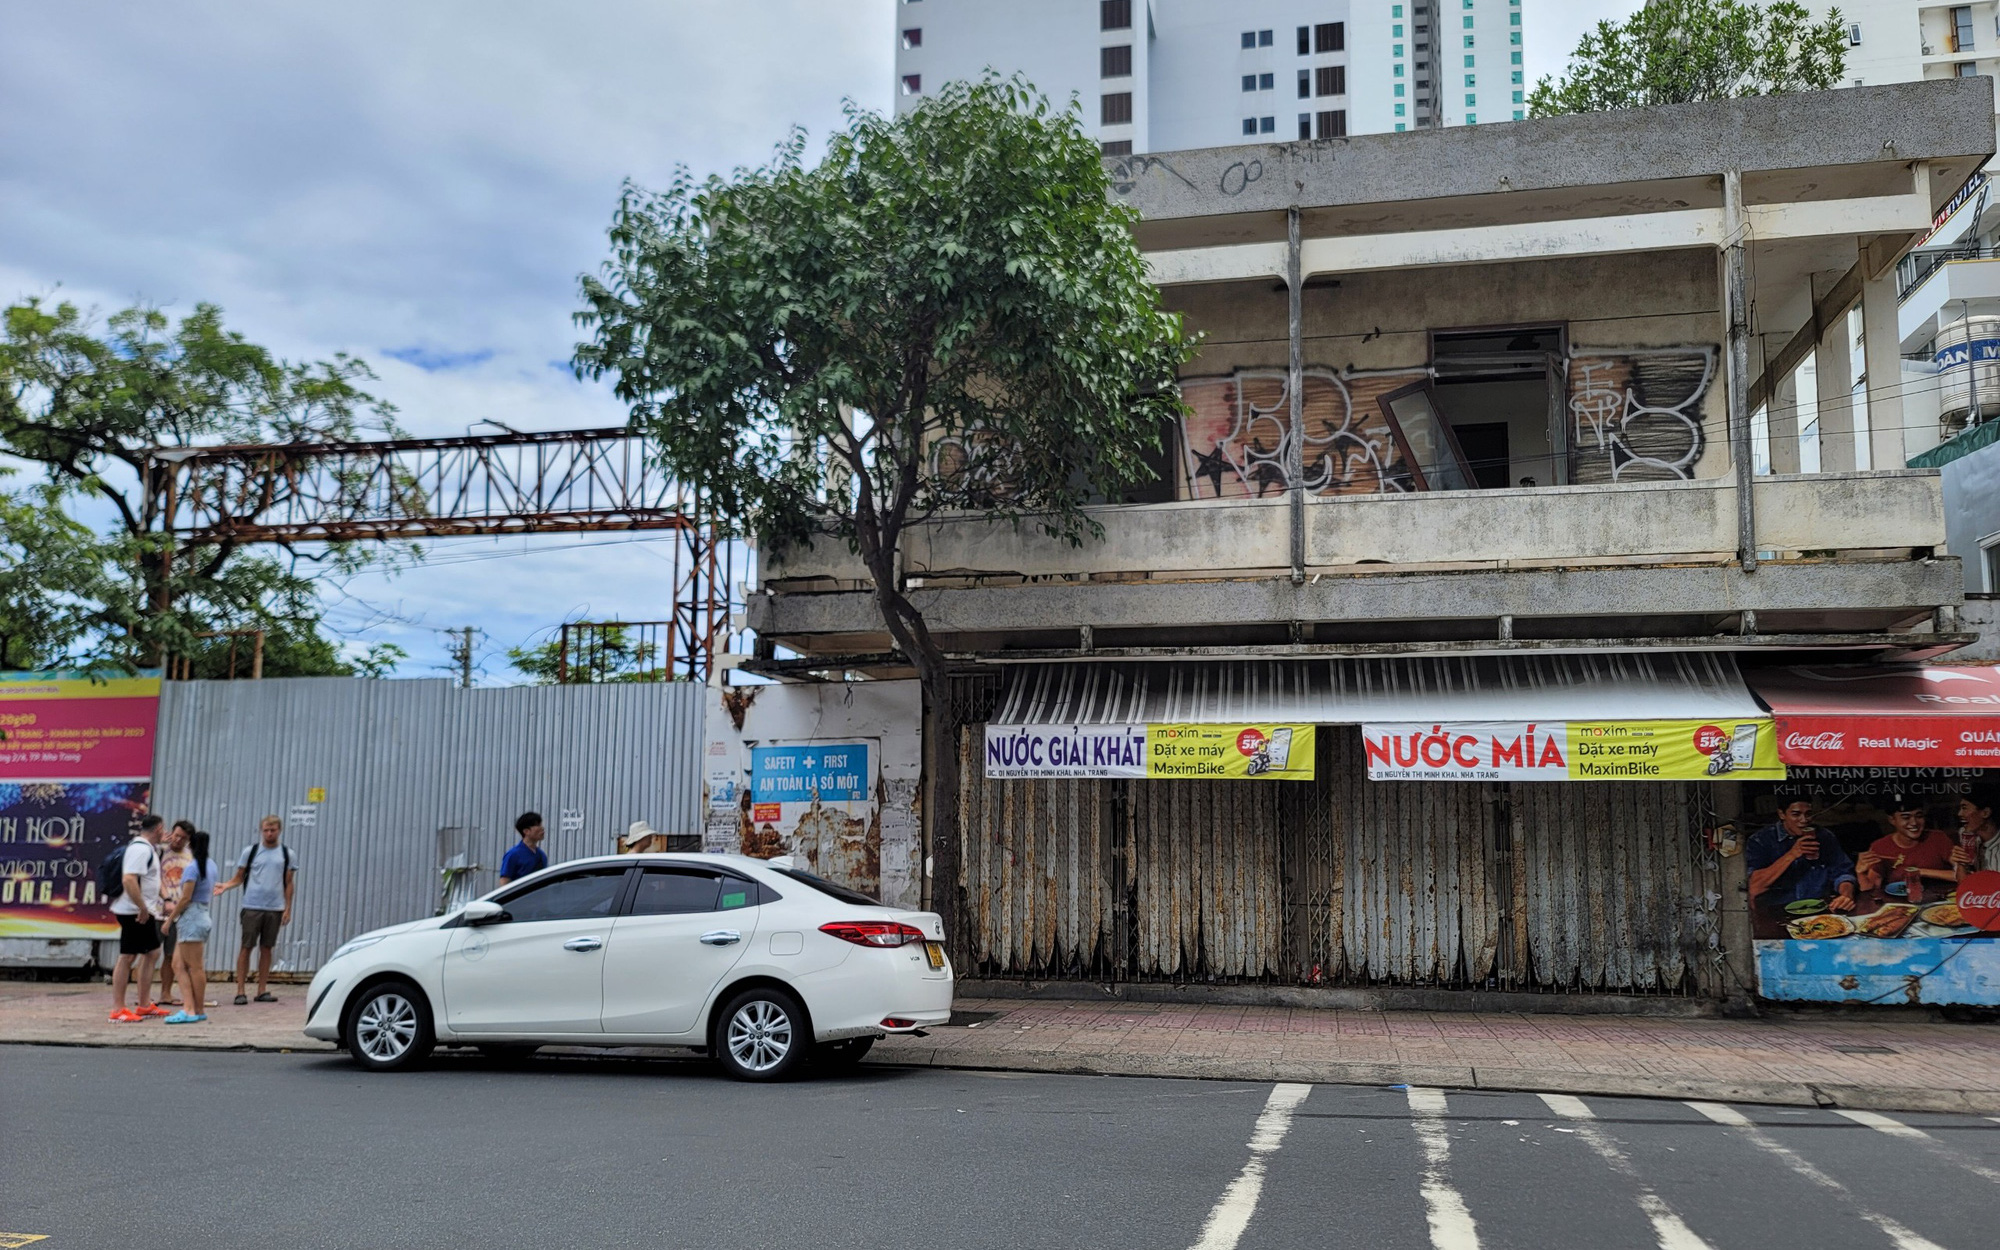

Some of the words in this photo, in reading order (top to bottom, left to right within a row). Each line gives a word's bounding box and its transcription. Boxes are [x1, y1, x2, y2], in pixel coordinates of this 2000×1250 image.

[1157, 727, 1198, 738] maxim
[1581, 725, 1627, 736] maxim
[988, 728, 1043, 766] NƯỚC
[1049, 726, 1087, 766] GIẢI
[1094, 727, 1144, 766] KHÁT
[1364, 725, 1480, 768] NƯỚC
[1492, 724, 1566, 768] MÍA
[1784, 731, 1846, 750] Coca-Cola
[1858, 737, 1890, 748] Real
[1154, 743, 1177, 758] Đặt
[1180, 746, 1195, 756] xe
[1199, 743, 1225, 758] máy
[1578, 742, 1604, 758] Đặt
[1608, 745, 1624, 755] xe
[1629, 742, 1659, 757] máy
[764, 756, 796, 770] SAFETY
[824, 755, 848, 768] FIRST
[1154, 762, 1225, 775] MaximBike
[1579, 762, 1660, 775] MaximBike
[1041, 769, 1055, 777] MINH
[1074, 769, 1086, 777] NHA
[1088, 769, 1108, 777] TRANG
[1476, 771, 1499, 779] TRANG
[760, 777, 774, 791] AN
[777, 774, 802, 790] TOÀN
[805, 773, 818, 790] LÀ
[820, 771, 835, 790] SỐ
[837, 773, 859, 792] MỘT
[1774, 784, 1800, 795] KHI
[1805, 784, 1825, 795] TA
[1910, 782, 1972, 795] CHUNG
